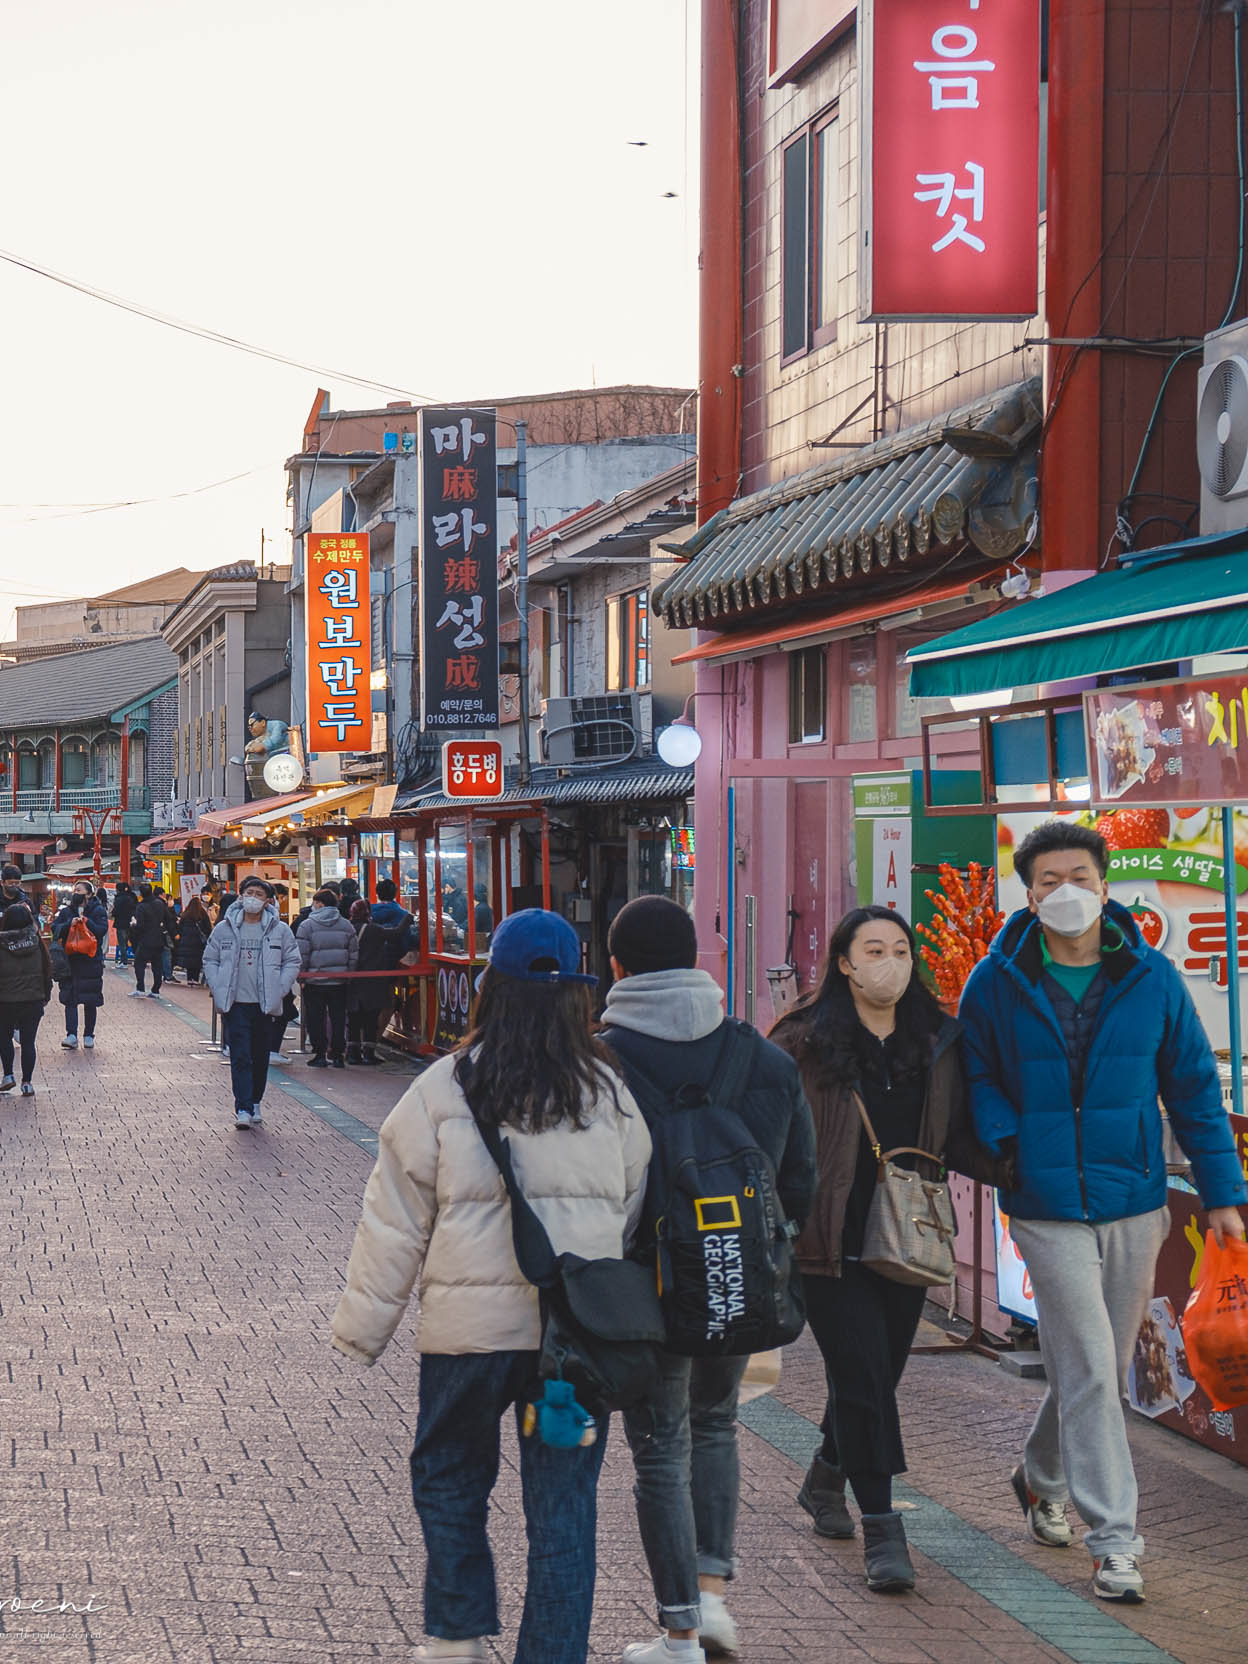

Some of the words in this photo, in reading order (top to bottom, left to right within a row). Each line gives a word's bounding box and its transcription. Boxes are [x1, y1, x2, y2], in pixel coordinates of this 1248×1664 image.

[913, 0, 995, 110] 음
[913, 161, 985, 252] 컷
[312, 550, 364, 563] 수제만두
[319, 539, 337, 549] 중국
[318, 568, 363, 742] 원보만두
[426, 713, 497, 724] 010.8812.7646
[440, 699, 483, 711] 예약/문의
[451, 752, 497, 784] 홍두병
[1110, 855, 1163, 871] 아이스
[758, 1169, 776, 1240] NATIONA
[704, 1235, 727, 1340] GEOGRAPHIC
[723, 1234, 745, 1321] NATIONAL
